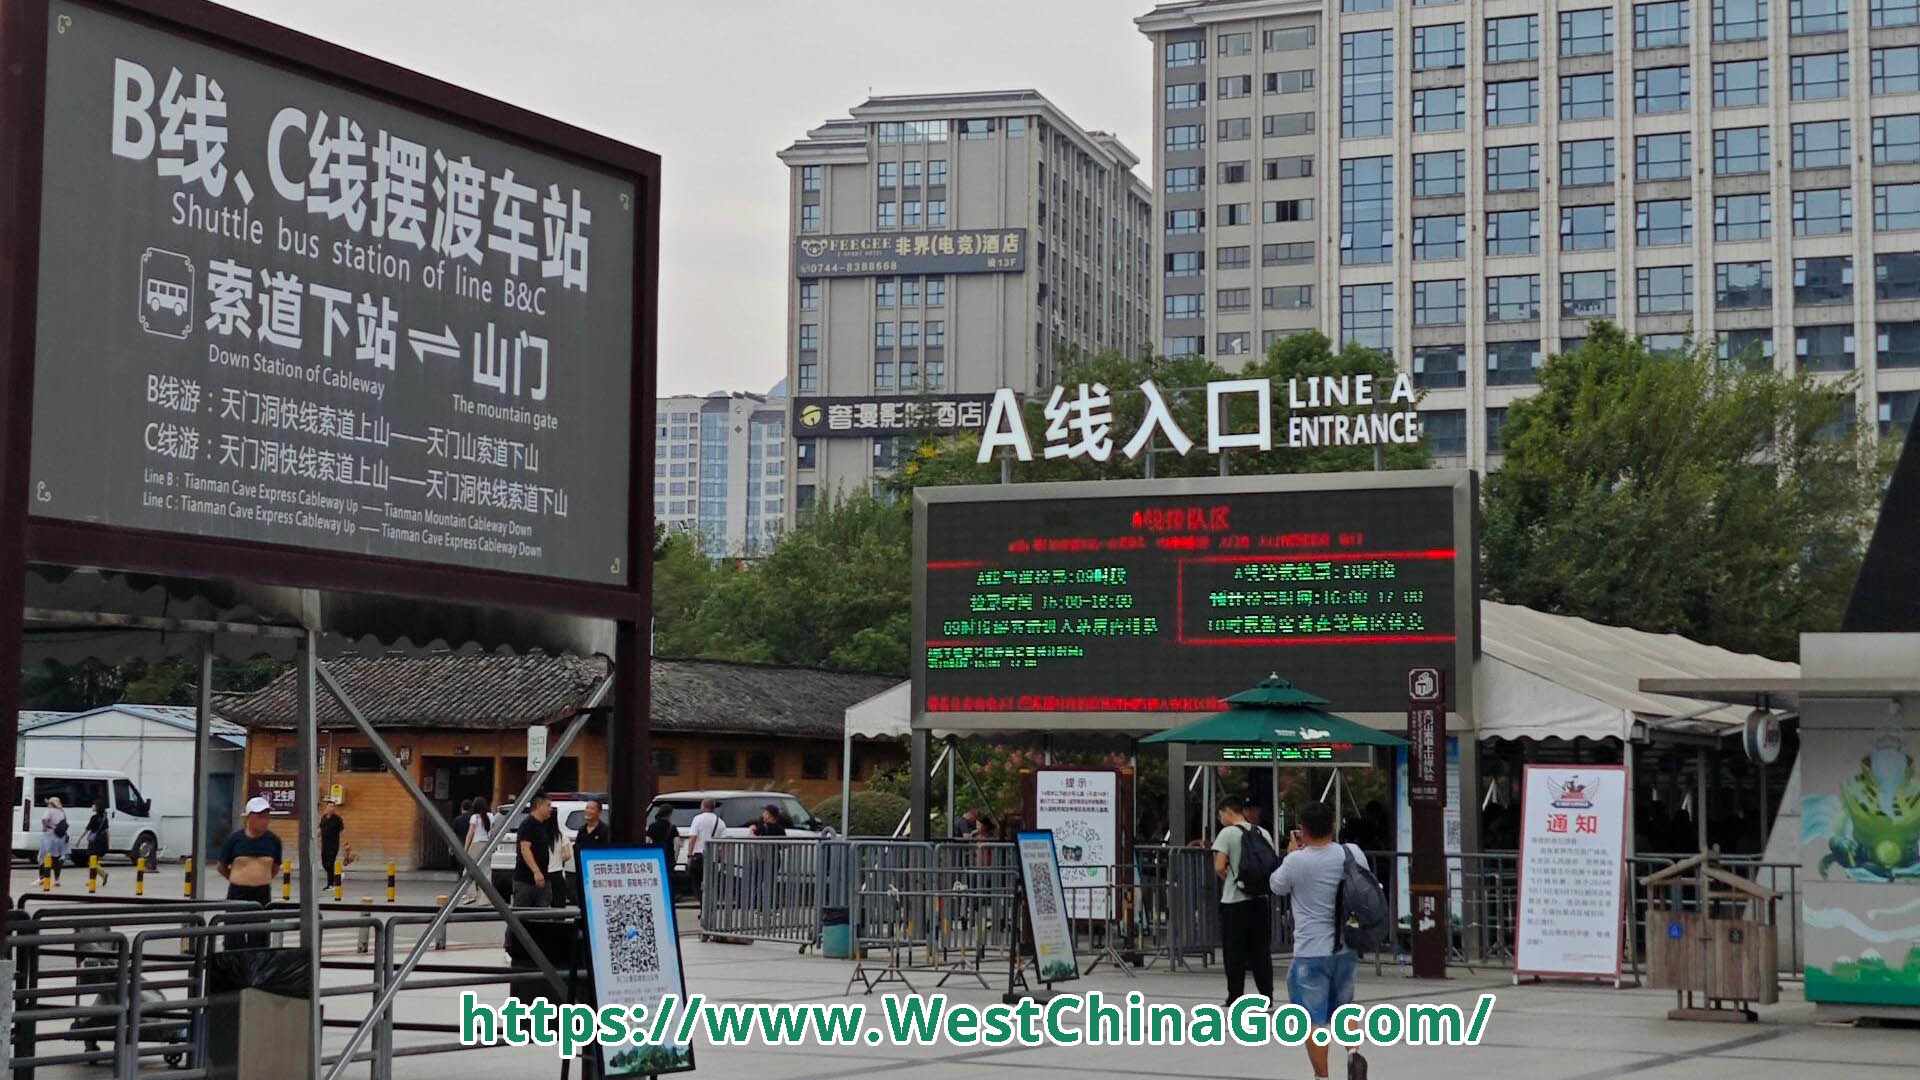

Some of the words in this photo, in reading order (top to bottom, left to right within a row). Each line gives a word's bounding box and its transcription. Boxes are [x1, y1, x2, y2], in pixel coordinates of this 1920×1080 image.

[111, 57, 591, 293] B线、C线摆渡车站
[172, 192, 263, 244] Shuttle
[278, 217, 319, 258] bus
[332, 239, 410, 282] station
[423, 260, 445, 291] of
[456, 264, 492, 302] line
[504, 278, 546, 315] B&C
[830, 237, 892, 251] FEEGEE
[895, 233, 1019, 256] 非界(电竞)酒店
[204, 258, 398, 371] 索道下站
[473, 322, 548, 401] 山门
[209, 344, 249, 369] Down
[253, 353, 302, 379] Station
[306, 365, 321, 383] of
[322, 367, 385, 400] Cableway
[1290, 375, 1373, 408] LINE
[1390, 373, 1415, 404] A
[452, 394, 474, 414] The
[477, 401, 531, 424] mountain
[533, 412, 558, 431] gate
[977, 378, 1273, 464] A线入口
[1289, 411, 1418, 448] ENTRANCE
[143, 492, 164, 509] Line
[181, 495, 226, 516] Tianman
[229, 502, 253, 520] Cave
[256, 506, 293, 526] Express
[295, 511, 342, 536] Cableway
[343, 519, 356, 534] Up
[382, 523, 420, 543] Tianman
[422, 530, 443, 546] Cave
[444, 534, 477, 552] Express
[478, 537, 517, 559] Cableway
[518, 541, 542, 556] Down
[144, 468, 165, 485] Line
[184, 473, 229, 494] Tianman
[232, 480, 257, 498] Cave
[259, 484, 296, 504] Express
[298, 490, 345, 514] Cableway
[347, 498, 358, 514] Up
[384, 502, 422, 522] Tianman
[424, 508, 467, 528] Mountain
[468, 515, 508, 537] Cableway
[509, 521, 532, 537] Down
[1546, 813, 1597, 834] 通知
